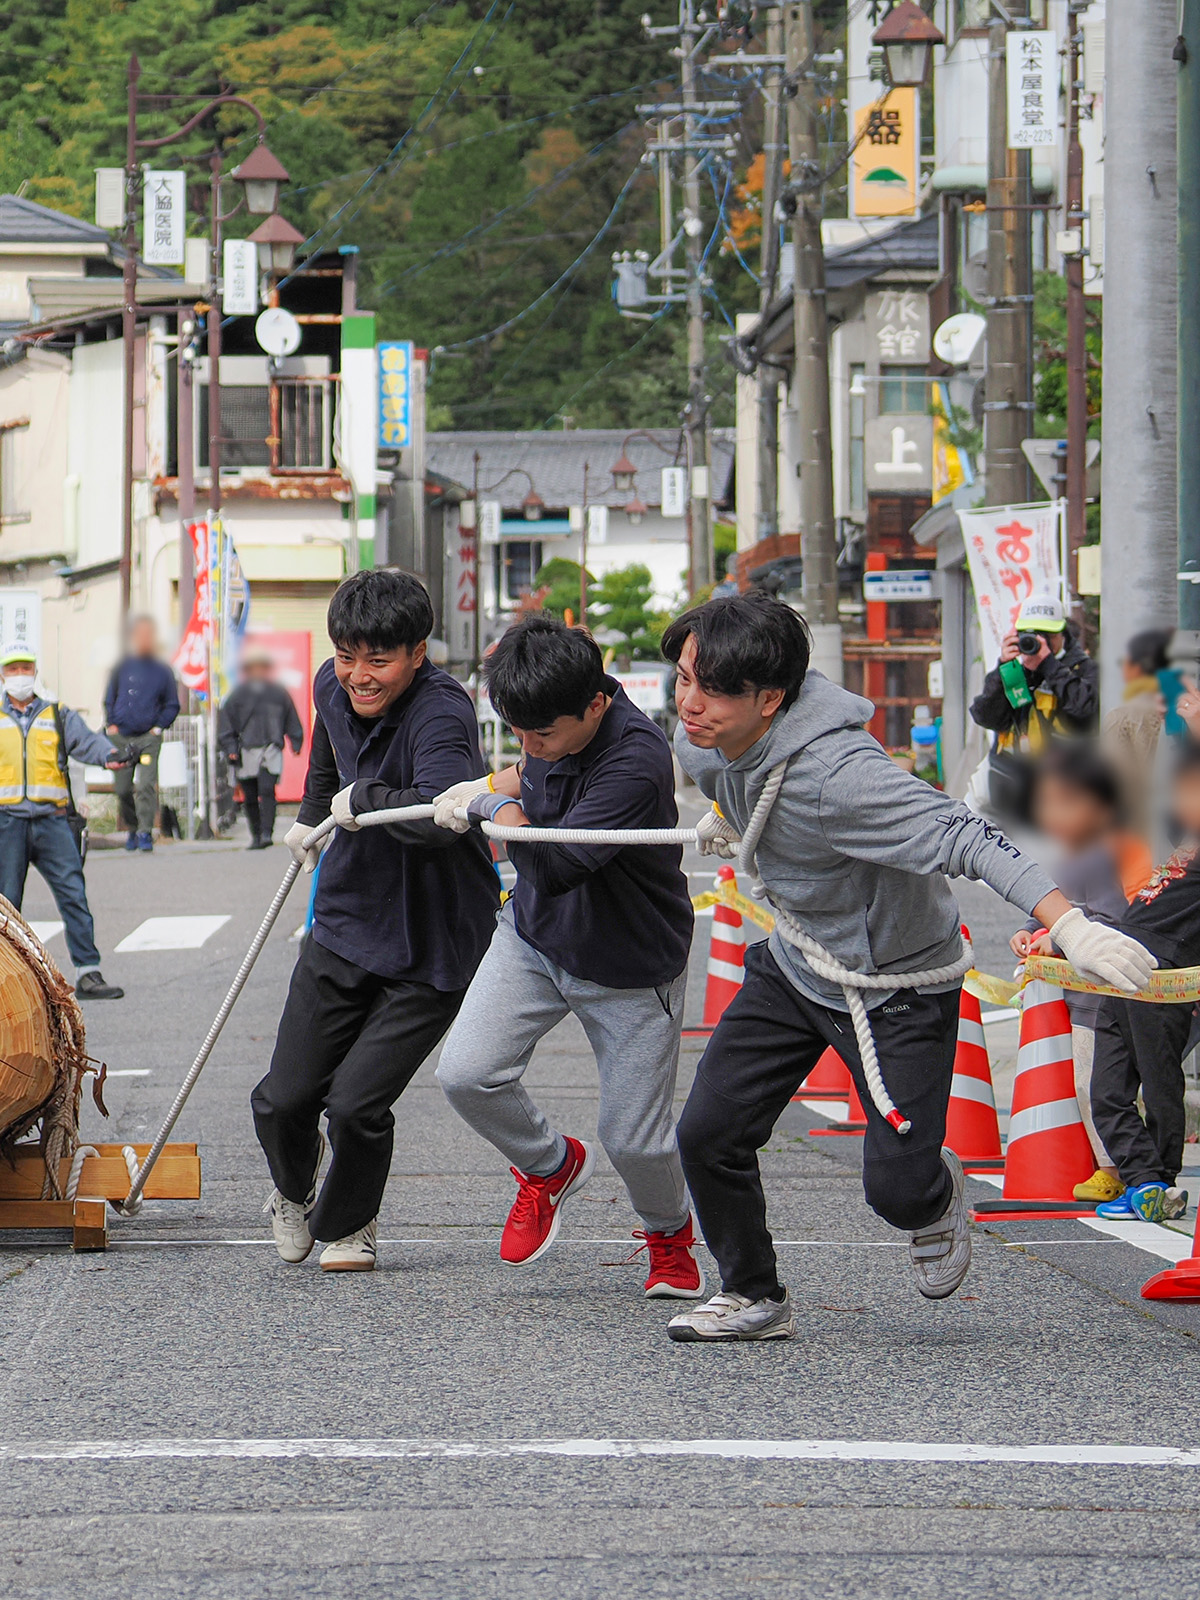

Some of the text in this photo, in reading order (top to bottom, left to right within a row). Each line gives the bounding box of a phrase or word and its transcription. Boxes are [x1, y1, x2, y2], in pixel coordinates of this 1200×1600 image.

[1020, 37, 1043, 126] 松本屋食堂
[877, 289, 921, 357] 旅館
[874, 426, 923, 473] 上
